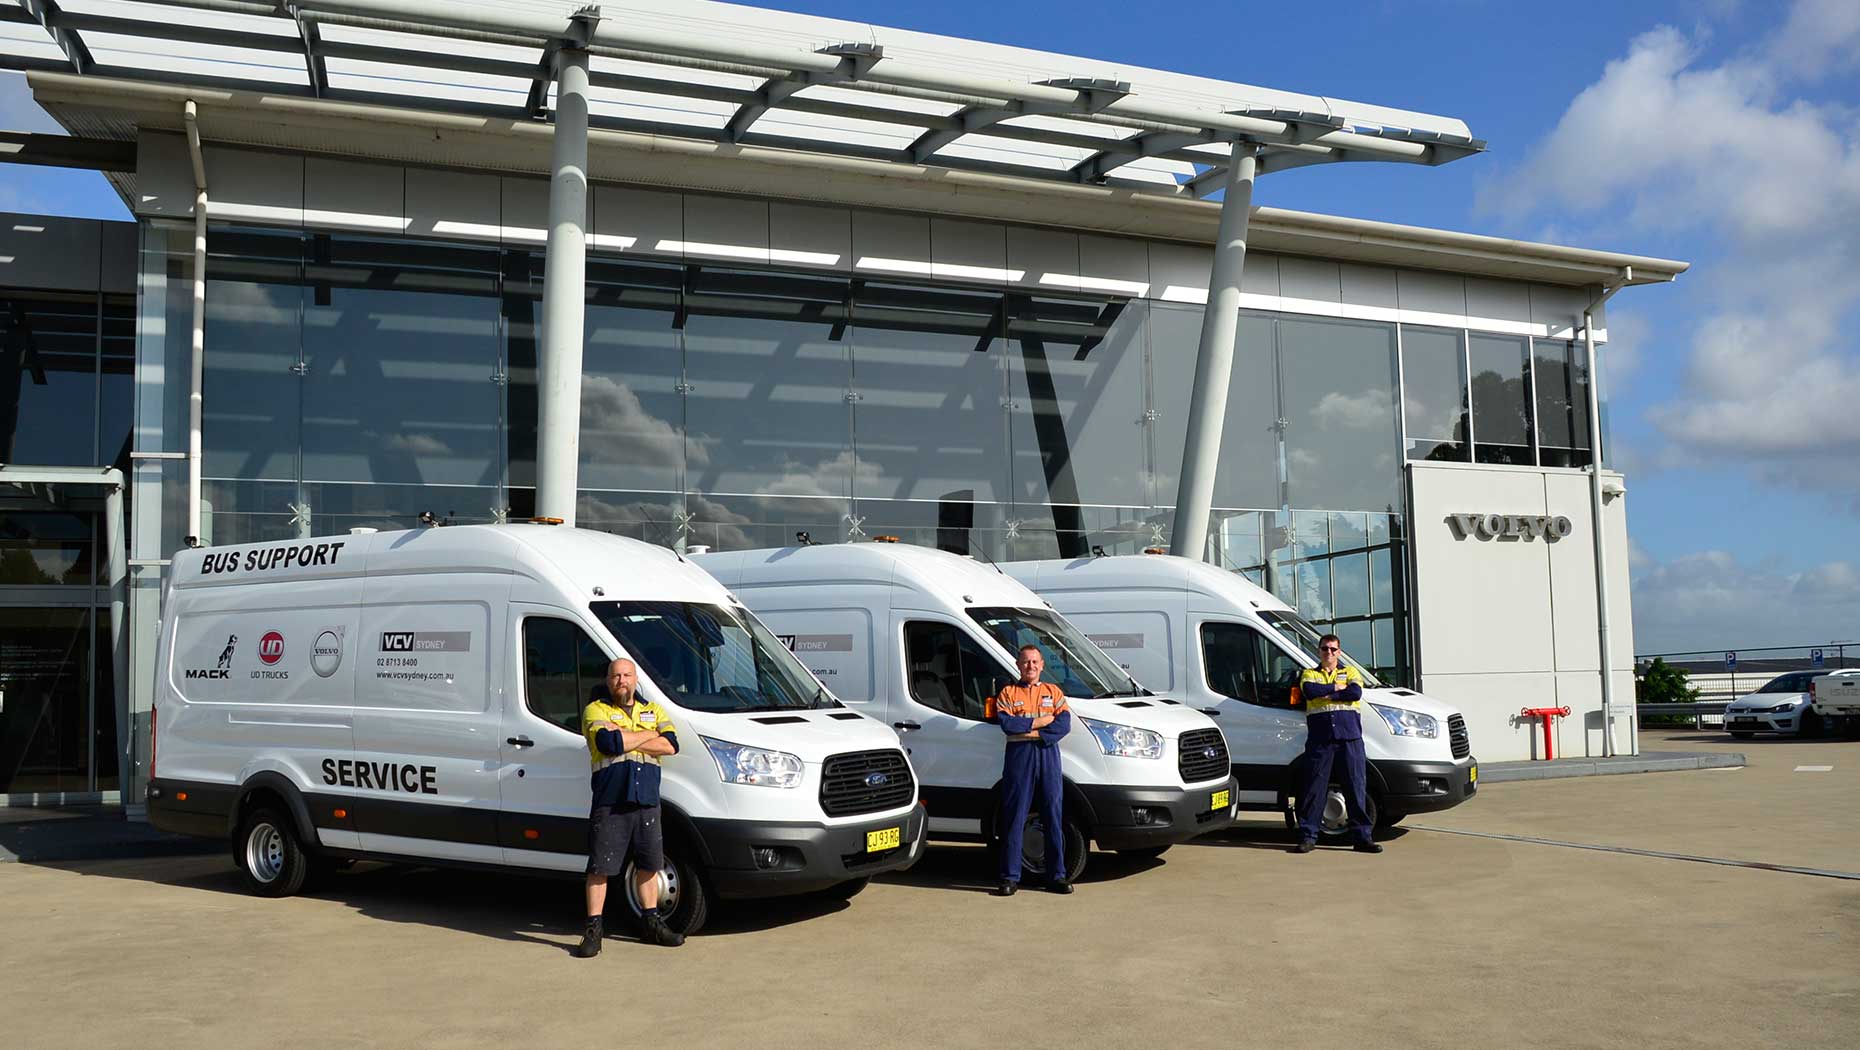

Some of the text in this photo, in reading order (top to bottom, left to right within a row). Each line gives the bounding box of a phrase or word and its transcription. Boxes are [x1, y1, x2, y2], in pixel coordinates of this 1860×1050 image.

[1449, 513, 1573, 537] VOLVO
[200, 542, 345, 575] BUS SUPPORT
[384, 634, 446, 649] VCV SYDNEY
[797, 641, 828, 650] SYDNEY
[1092, 639, 1119, 648] YDNEY
[260, 639, 284, 656] UD
[1812, 649, 1821, 661] P
[376, 658, 418, 667] 02 8713 8400
[185, 669, 229, 680] MACK
[250, 671, 289, 680] UD TRUCKS
[376, 671, 455, 682] www.vcvsydney.com.au
[1829, 688, 1860, 697] ISUZ
[321, 758, 438, 795] SERVICE
